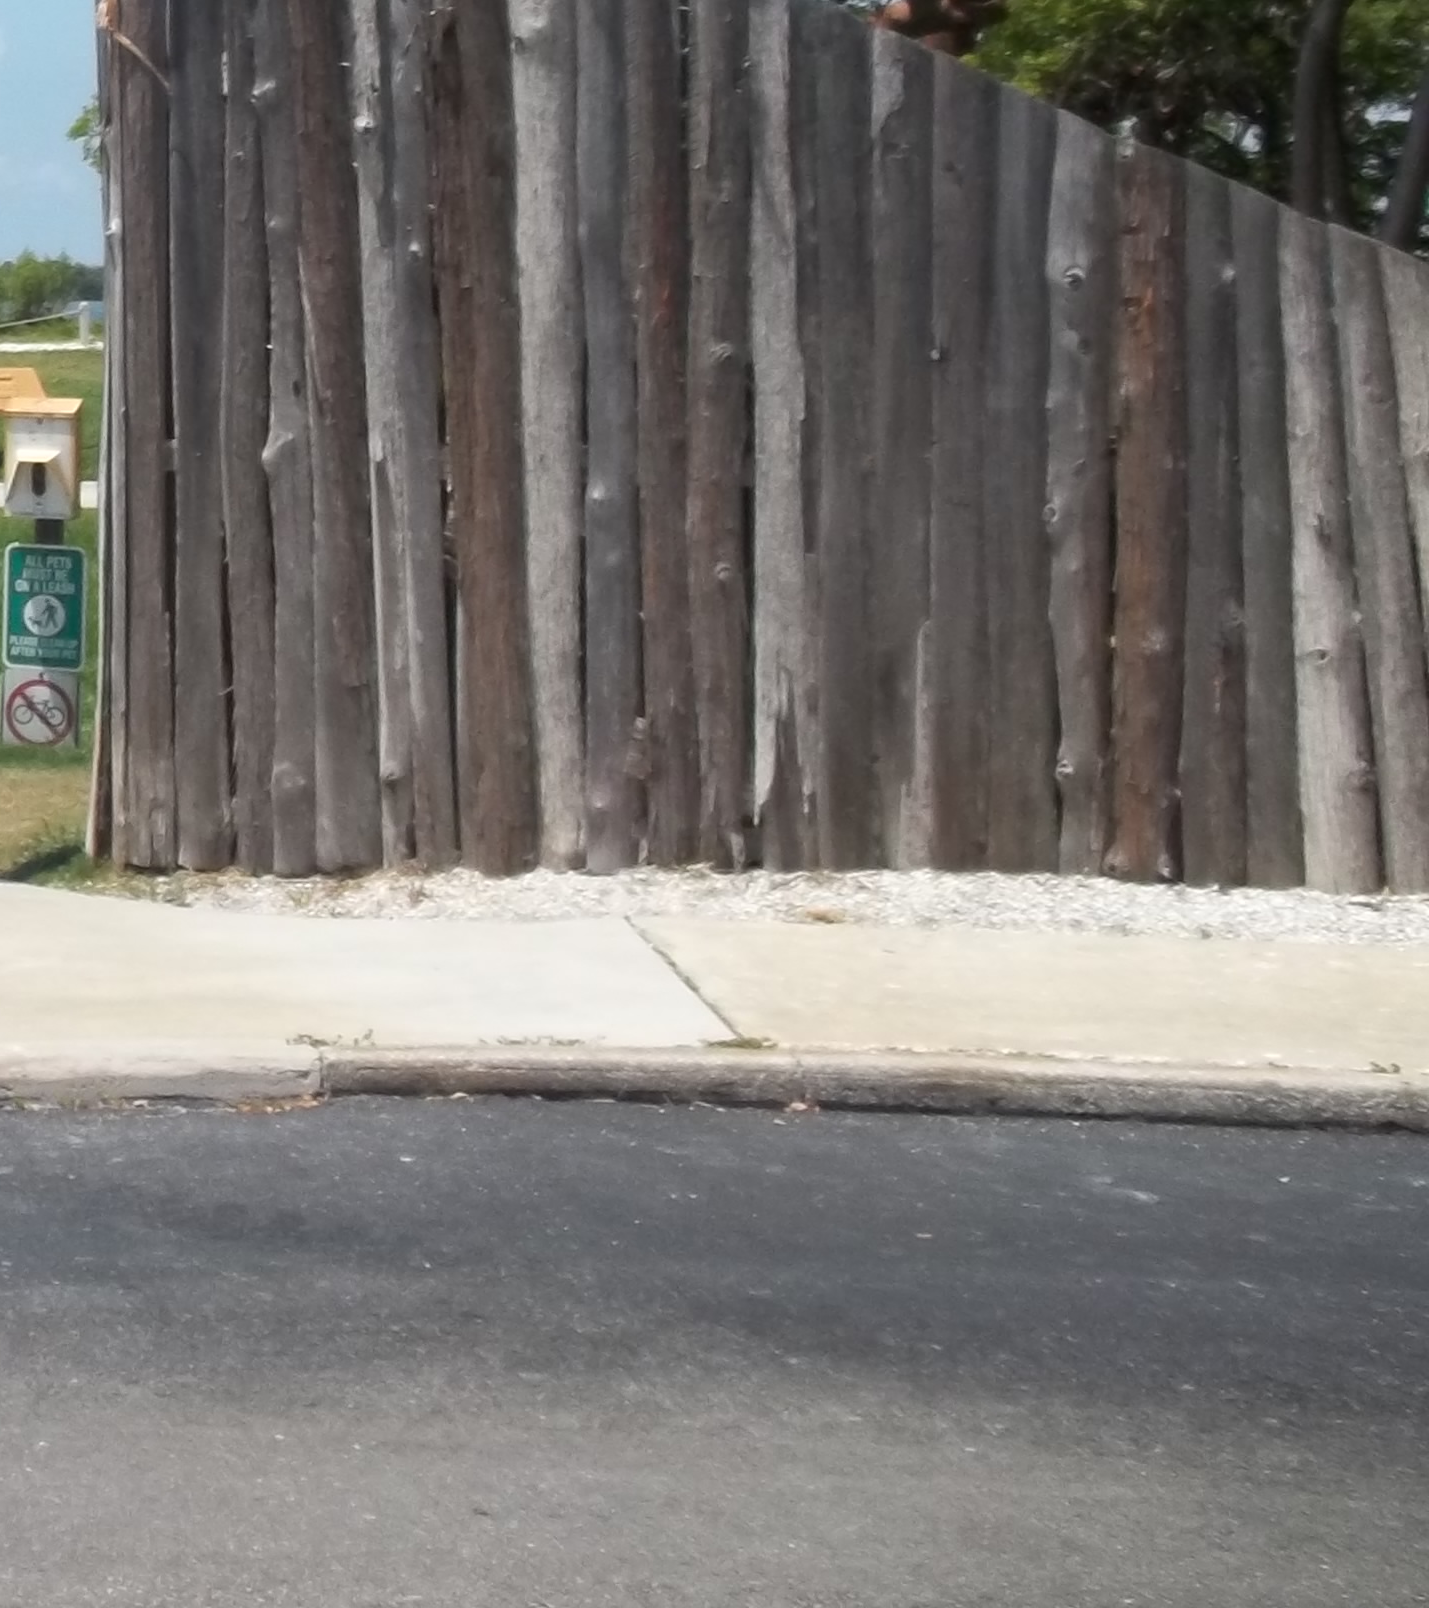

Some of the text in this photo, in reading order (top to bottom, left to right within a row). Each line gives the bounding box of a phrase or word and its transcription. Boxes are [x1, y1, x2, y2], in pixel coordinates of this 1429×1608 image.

[25, 555, 72, 569] ALL PETS
[22, 567, 68, 581] MUST BE
[14, 579, 30, 592] ON
[42, 581, 75, 594] LEASH
[9, 635, 38, 646] PLEASE
[10, 646, 37, 657] AFTER
